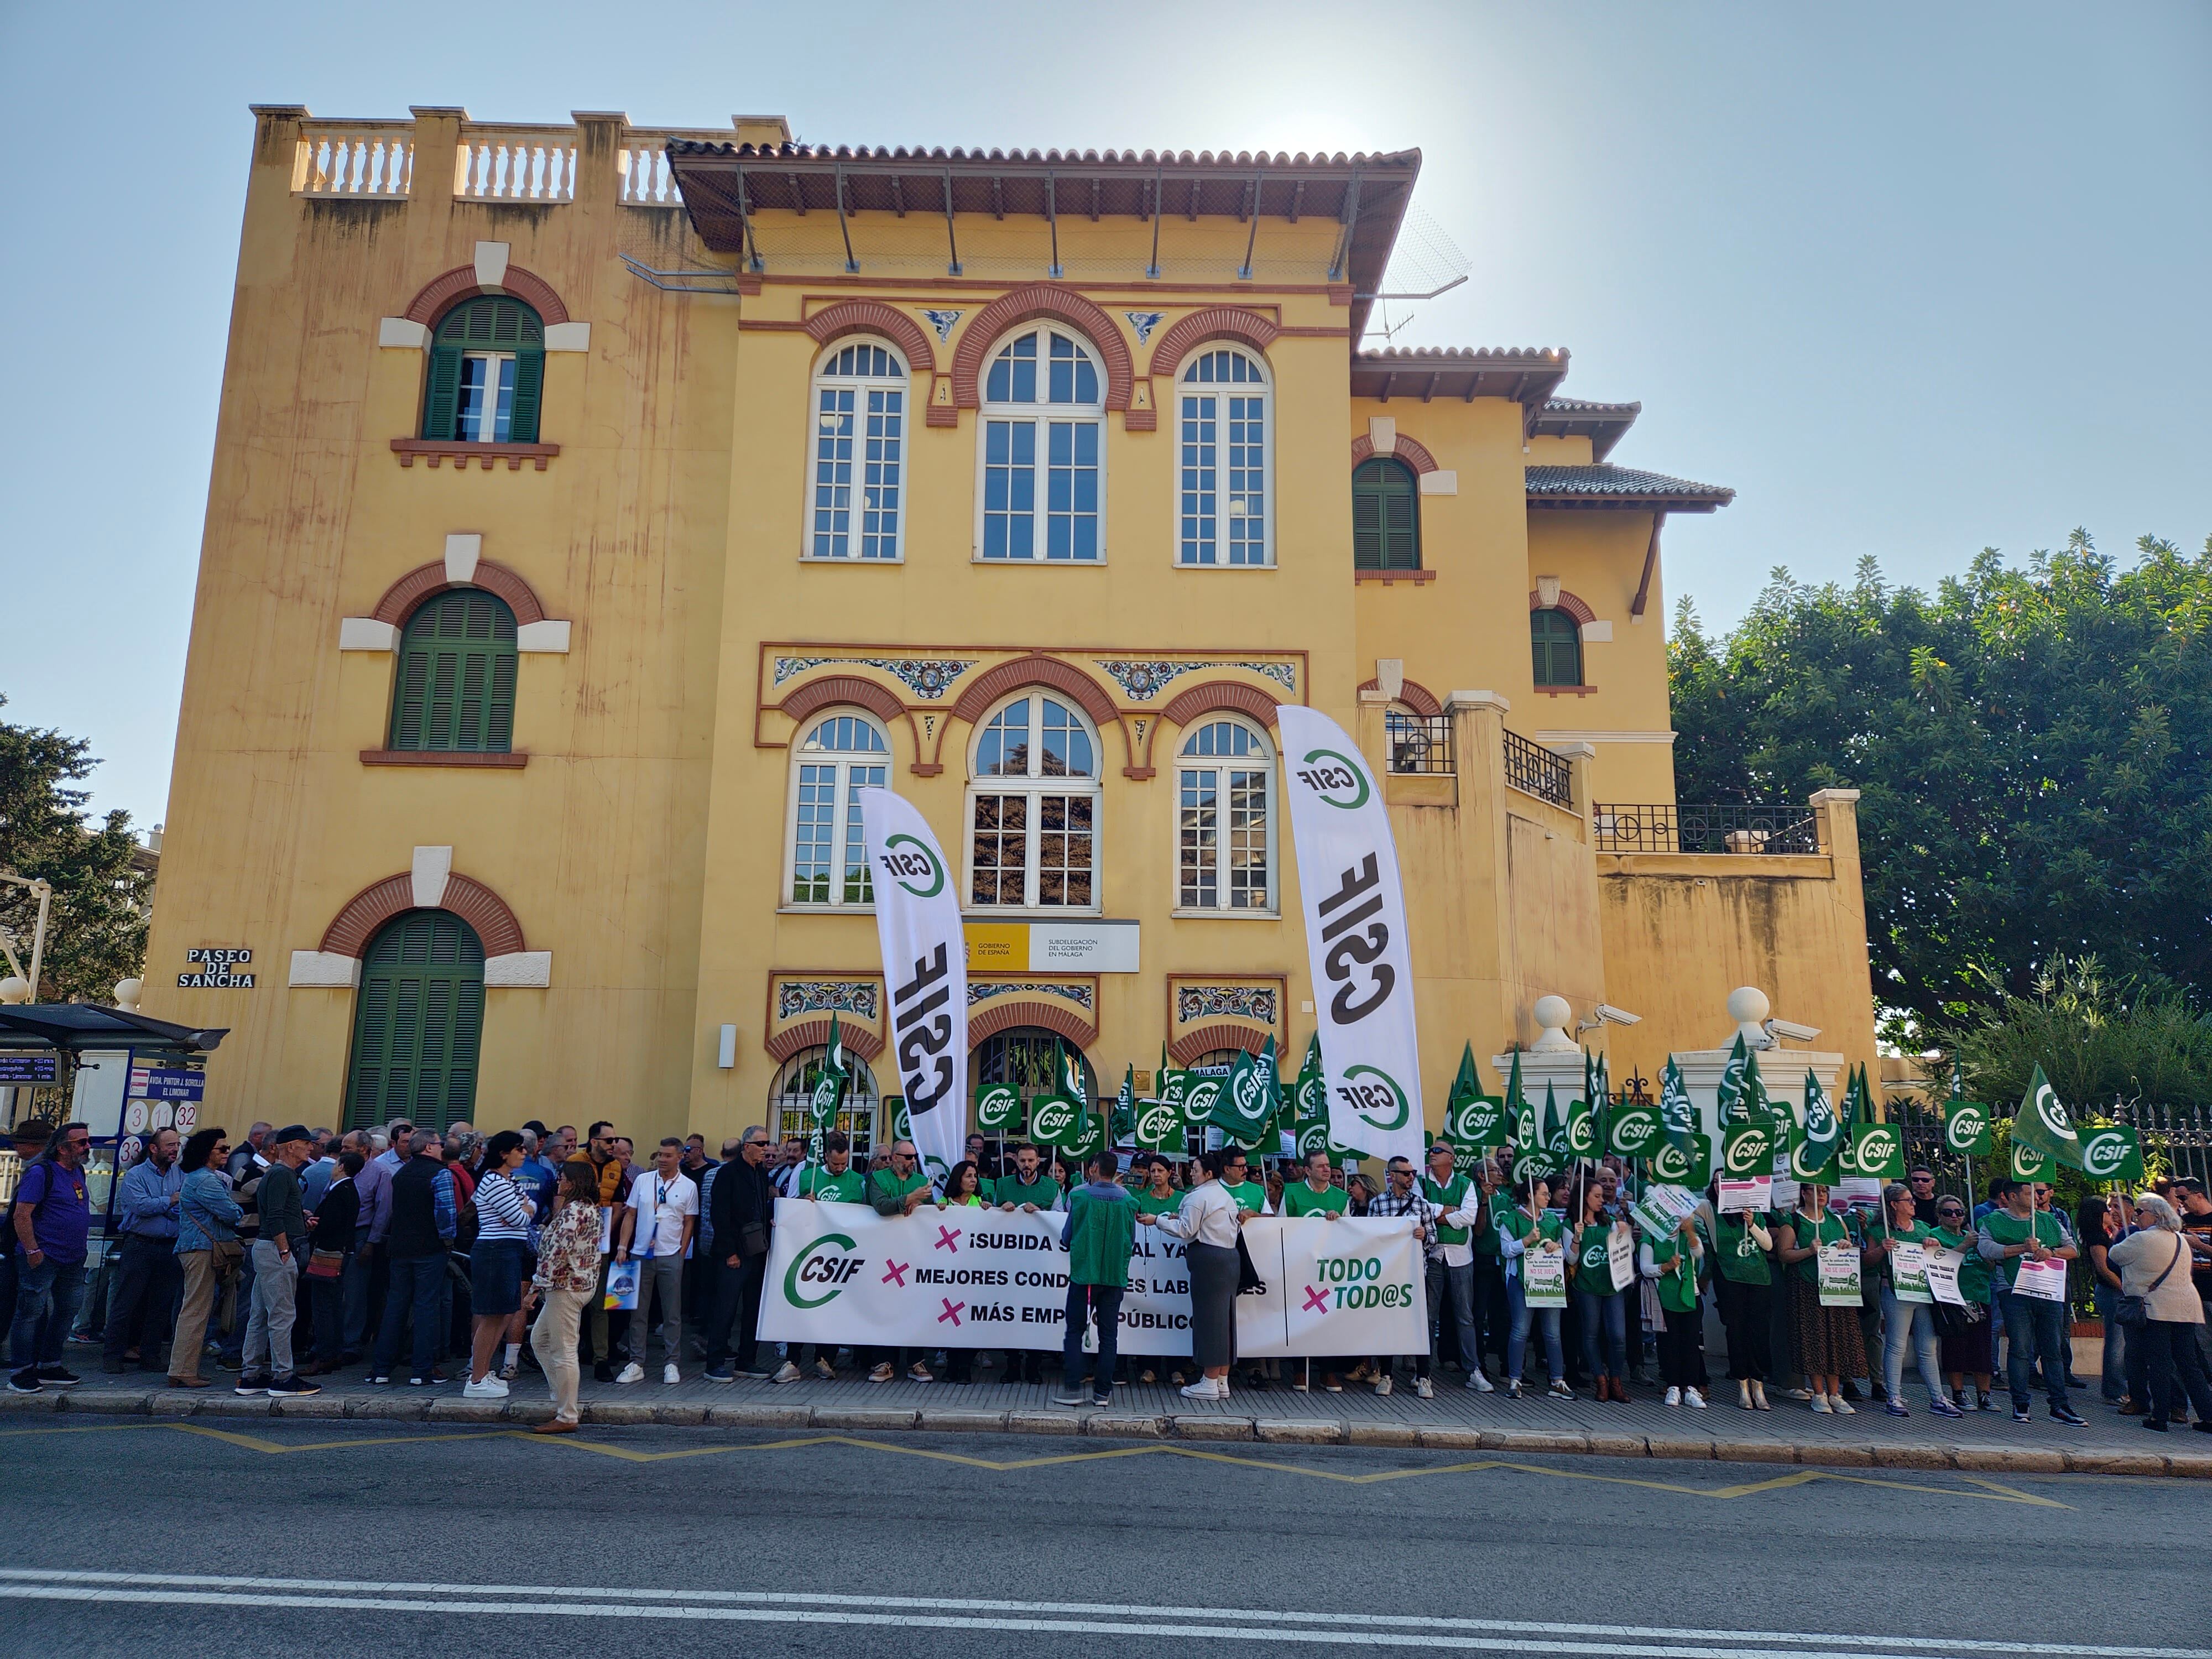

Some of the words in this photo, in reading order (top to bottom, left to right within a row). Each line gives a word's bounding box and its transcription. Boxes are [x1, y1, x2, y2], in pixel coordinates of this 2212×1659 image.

[187, 950, 251, 963] PASEO
[206, 962, 229, 975] DE
[179, 974, 253, 988] SANCHA
[149, 1076, 163, 1085] AVDA.
[164, 1077, 180, 1086] PINTOR
[163, 1088, 169, 1096] EL
[169, 1088, 189, 1097] LIMONAR
[817, 1092, 836, 1107] CSIF
[1192, 1093, 1218, 1107] CSI
[987, 1098, 1016, 1113] CSIF
[132, 1108, 142, 1127] 3
[155, 1108, 169, 1127] 11
[178, 1107, 196, 1126] 32
[1041, 1112, 1074, 1127] CSIF
[1466, 1113, 1499, 1128] CSIF
[1146, 1117, 1180, 1132] CSIF
[1522, 1121, 1535, 1137] CSIF
[1621, 1124, 1657, 1139] CSIF
[1775, 1119, 1792, 1134] SIF
[1955, 1119, 1985, 1135] CSIF
[1077, 1130, 1100, 1144] SIF
[121, 1141, 140, 1162] 33
[1735, 1142, 1769, 1157] CSIF
[1865, 1142, 1896, 1158] CSIF
[2093, 1145, 2132, 1161] CSIF
[1454, 1155, 1477, 1168] SIF
[1665, 1149, 1705, 1166] CSF
[1522, 1161, 1557, 1179] CSIF
[820, 1191, 842, 1202] CSIF
[969, 1233, 1053, 1251] ¡SUBIDA
[801, 1256, 866, 1284] CSIF
[1317, 1257, 1381, 1282] TODO
[915, 1269, 1009, 1286] MEJORES
[1334, 1284, 1413, 1310] TOD@S
[971, 1302, 1015, 1322] MÁS
[1117, 1308, 1193, 1330] PÚBLIC
